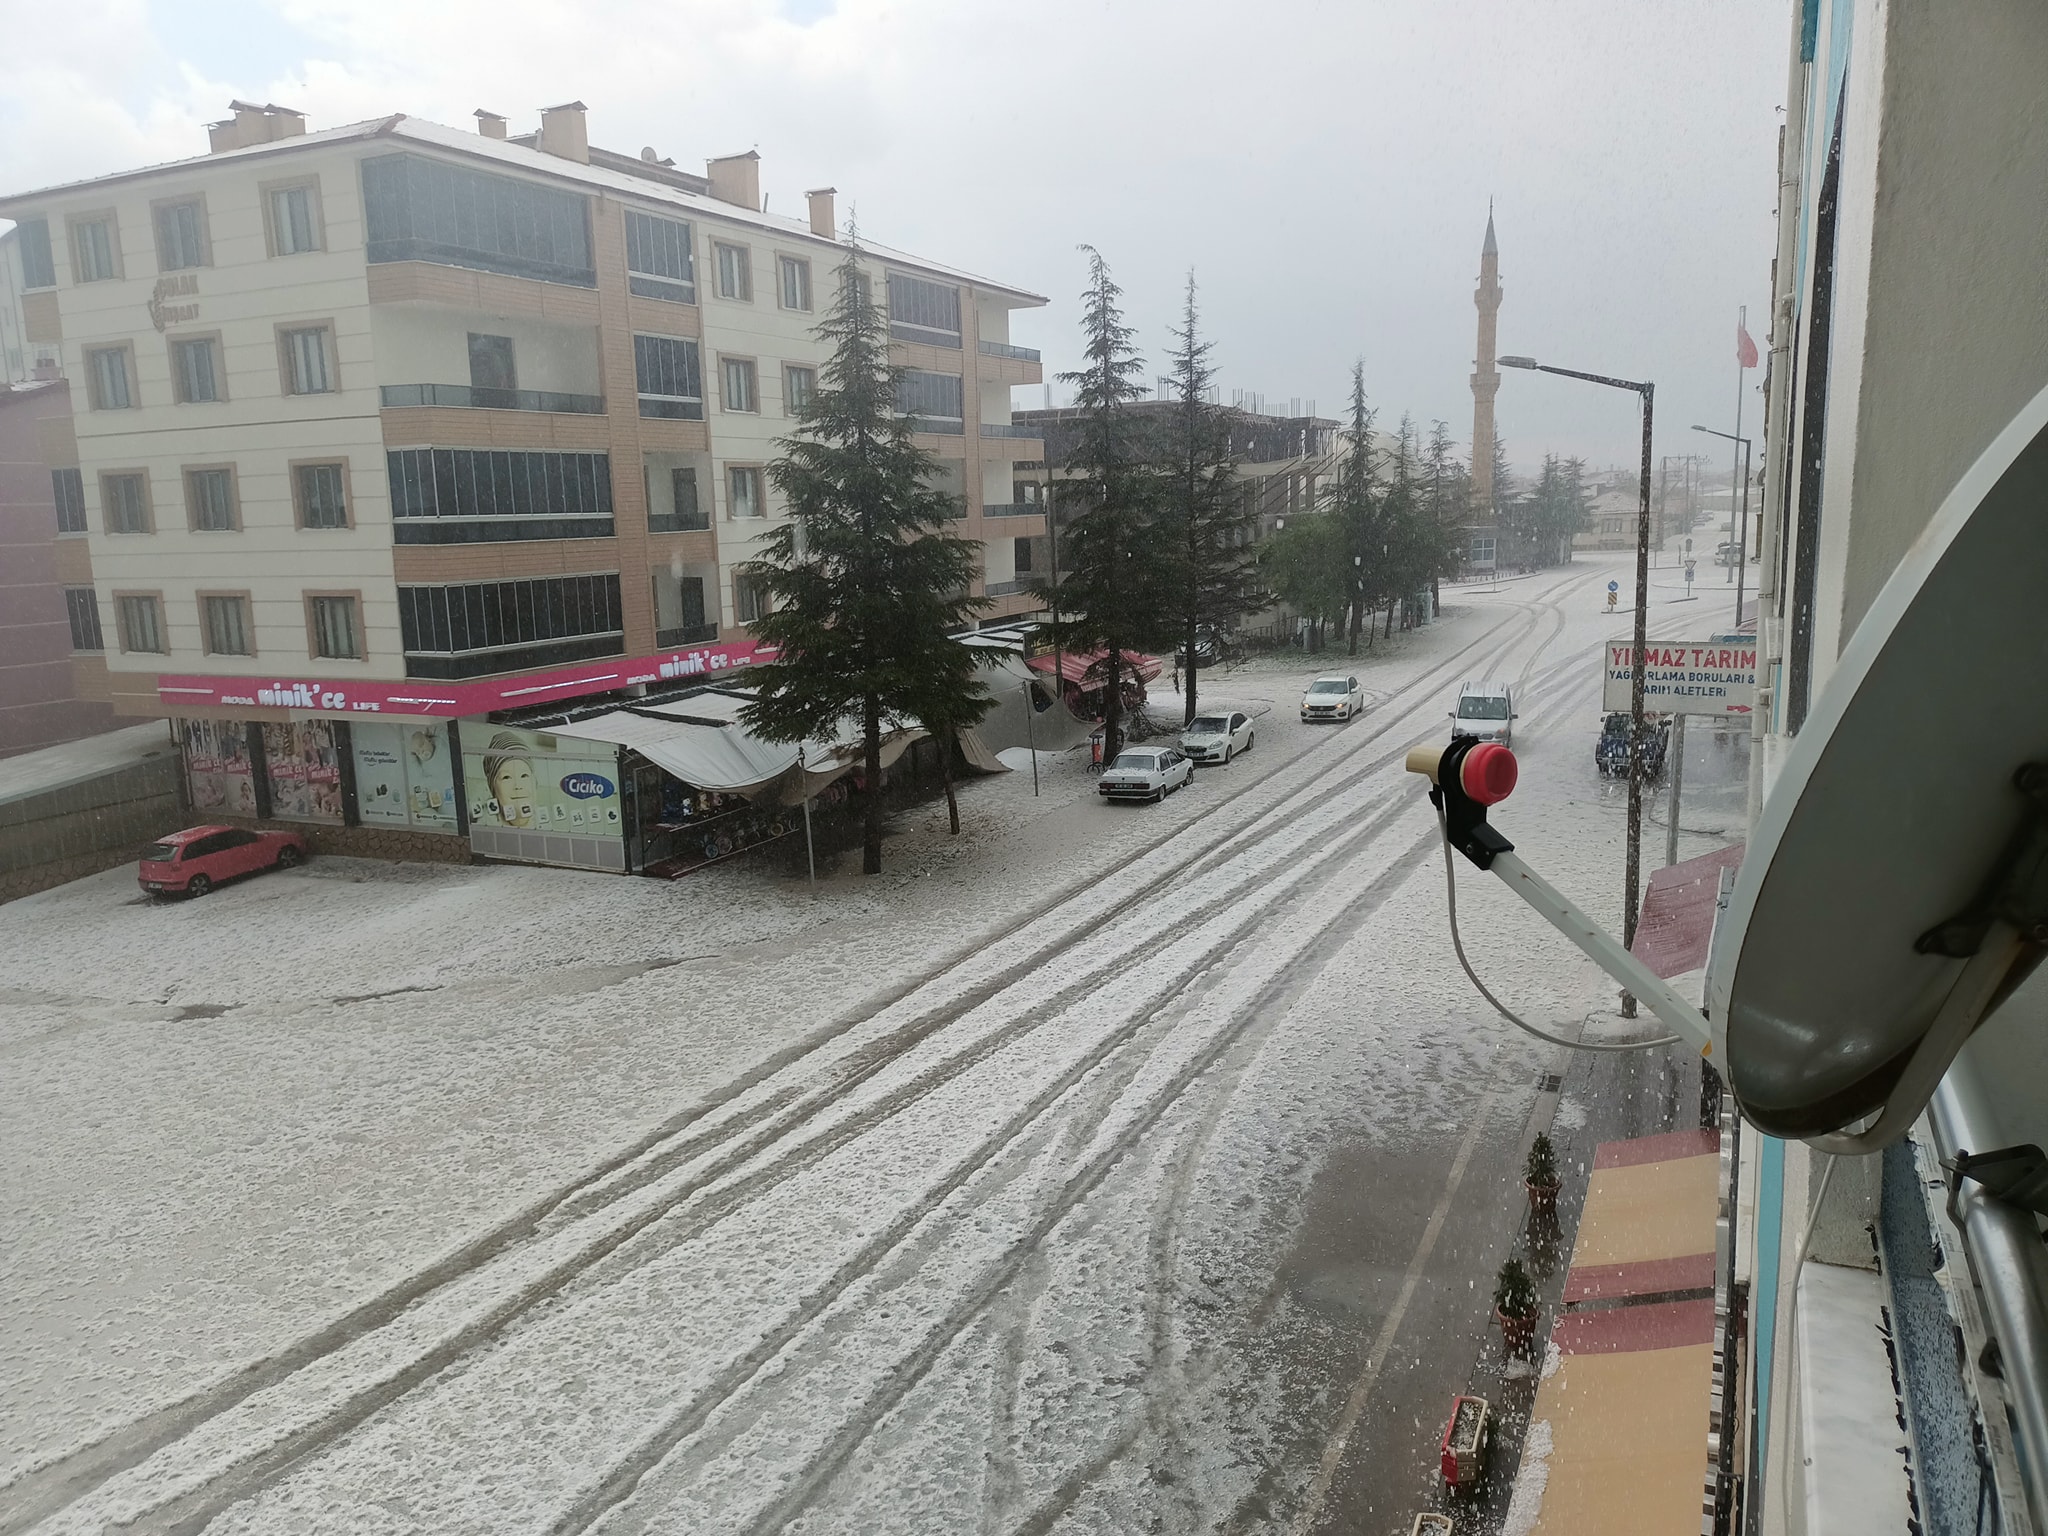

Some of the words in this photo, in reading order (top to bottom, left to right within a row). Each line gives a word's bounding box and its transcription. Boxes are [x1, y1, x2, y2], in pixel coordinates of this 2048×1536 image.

[1691, 649, 1756, 669] TARIM
[1609, 667, 1686, 682] YAĞRLAMA
[1689, 671, 1745, 684] BORULARI
[1747, 674, 1756, 684] &
[1639, 685, 1671, 695] ARIM
[352, 701, 381, 711] LIFE
[568, 778, 604, 794] Ciciko
